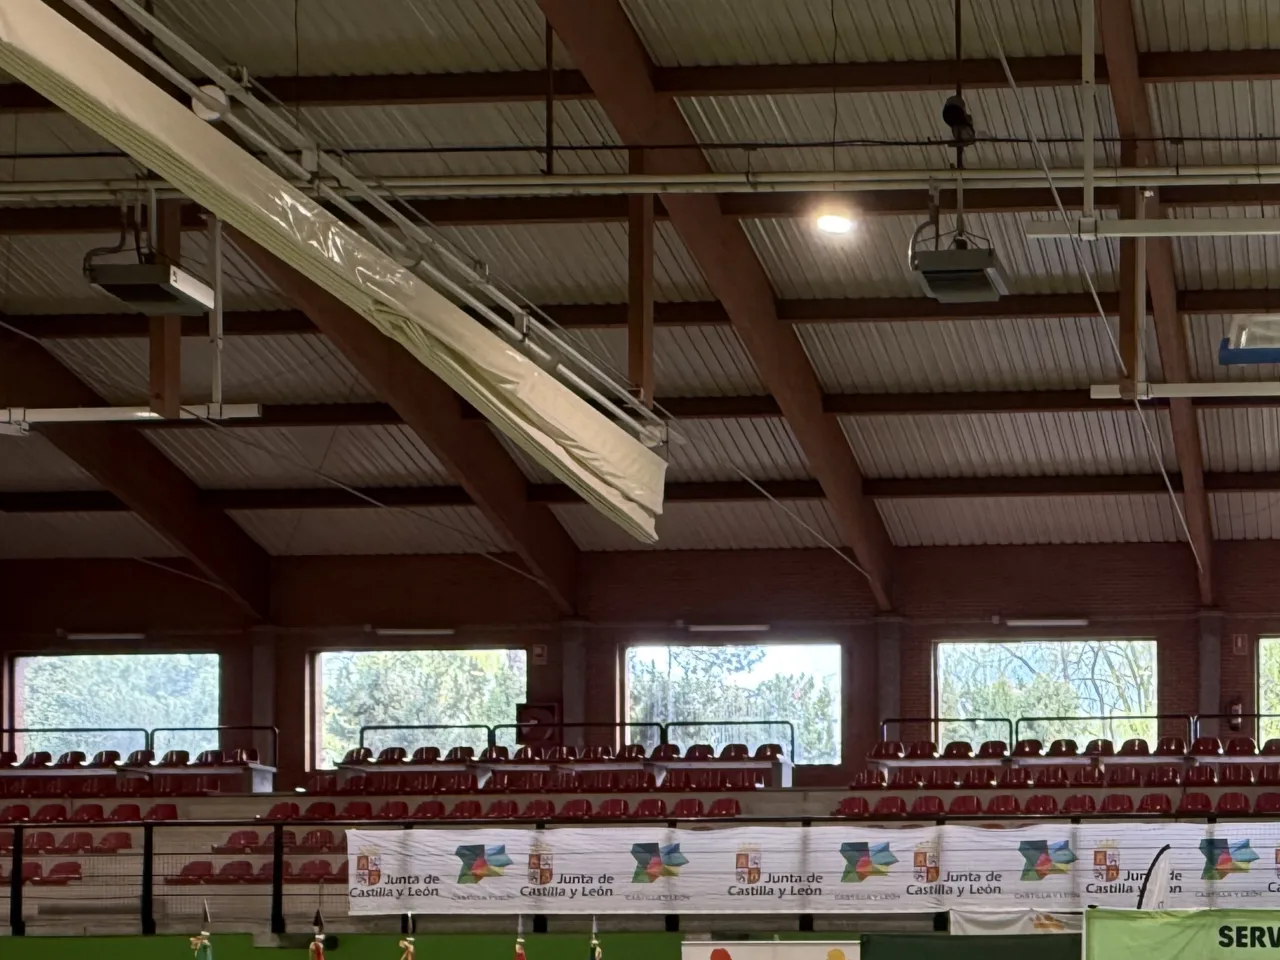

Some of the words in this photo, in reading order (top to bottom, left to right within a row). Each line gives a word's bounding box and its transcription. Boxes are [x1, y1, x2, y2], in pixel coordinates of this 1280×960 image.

[384, 874, 420, 885] Junta
[424, 874, 440, 885] de
[557, 874, 593, 884] Junta
[598, 874, 614, 884] de
[764, 873, 802, 884] Junta
[806, 873, 823, 884] de
[943, 872, 981, 882] Junta
[986, 871, 1002, 882] de
[350, 887, 393, 898] Castilla
[397, 889, 404, 900] y
[408, 887, 439, 897] León
[520, 886, 565, 897] Castilla
[570, 888, 578, 899] y
[582, 885, 613, 897] León
[728, 885, 774, 896] Castilla
[778, 888, 786, 899] y
[790, 885, 822, 896] León
[906, 884, 952, 896] Castilla
[957, 887, 964, 898] y
[970, 884, 1002, 895] León
[1086, 883, 1133, 894] Castilla
